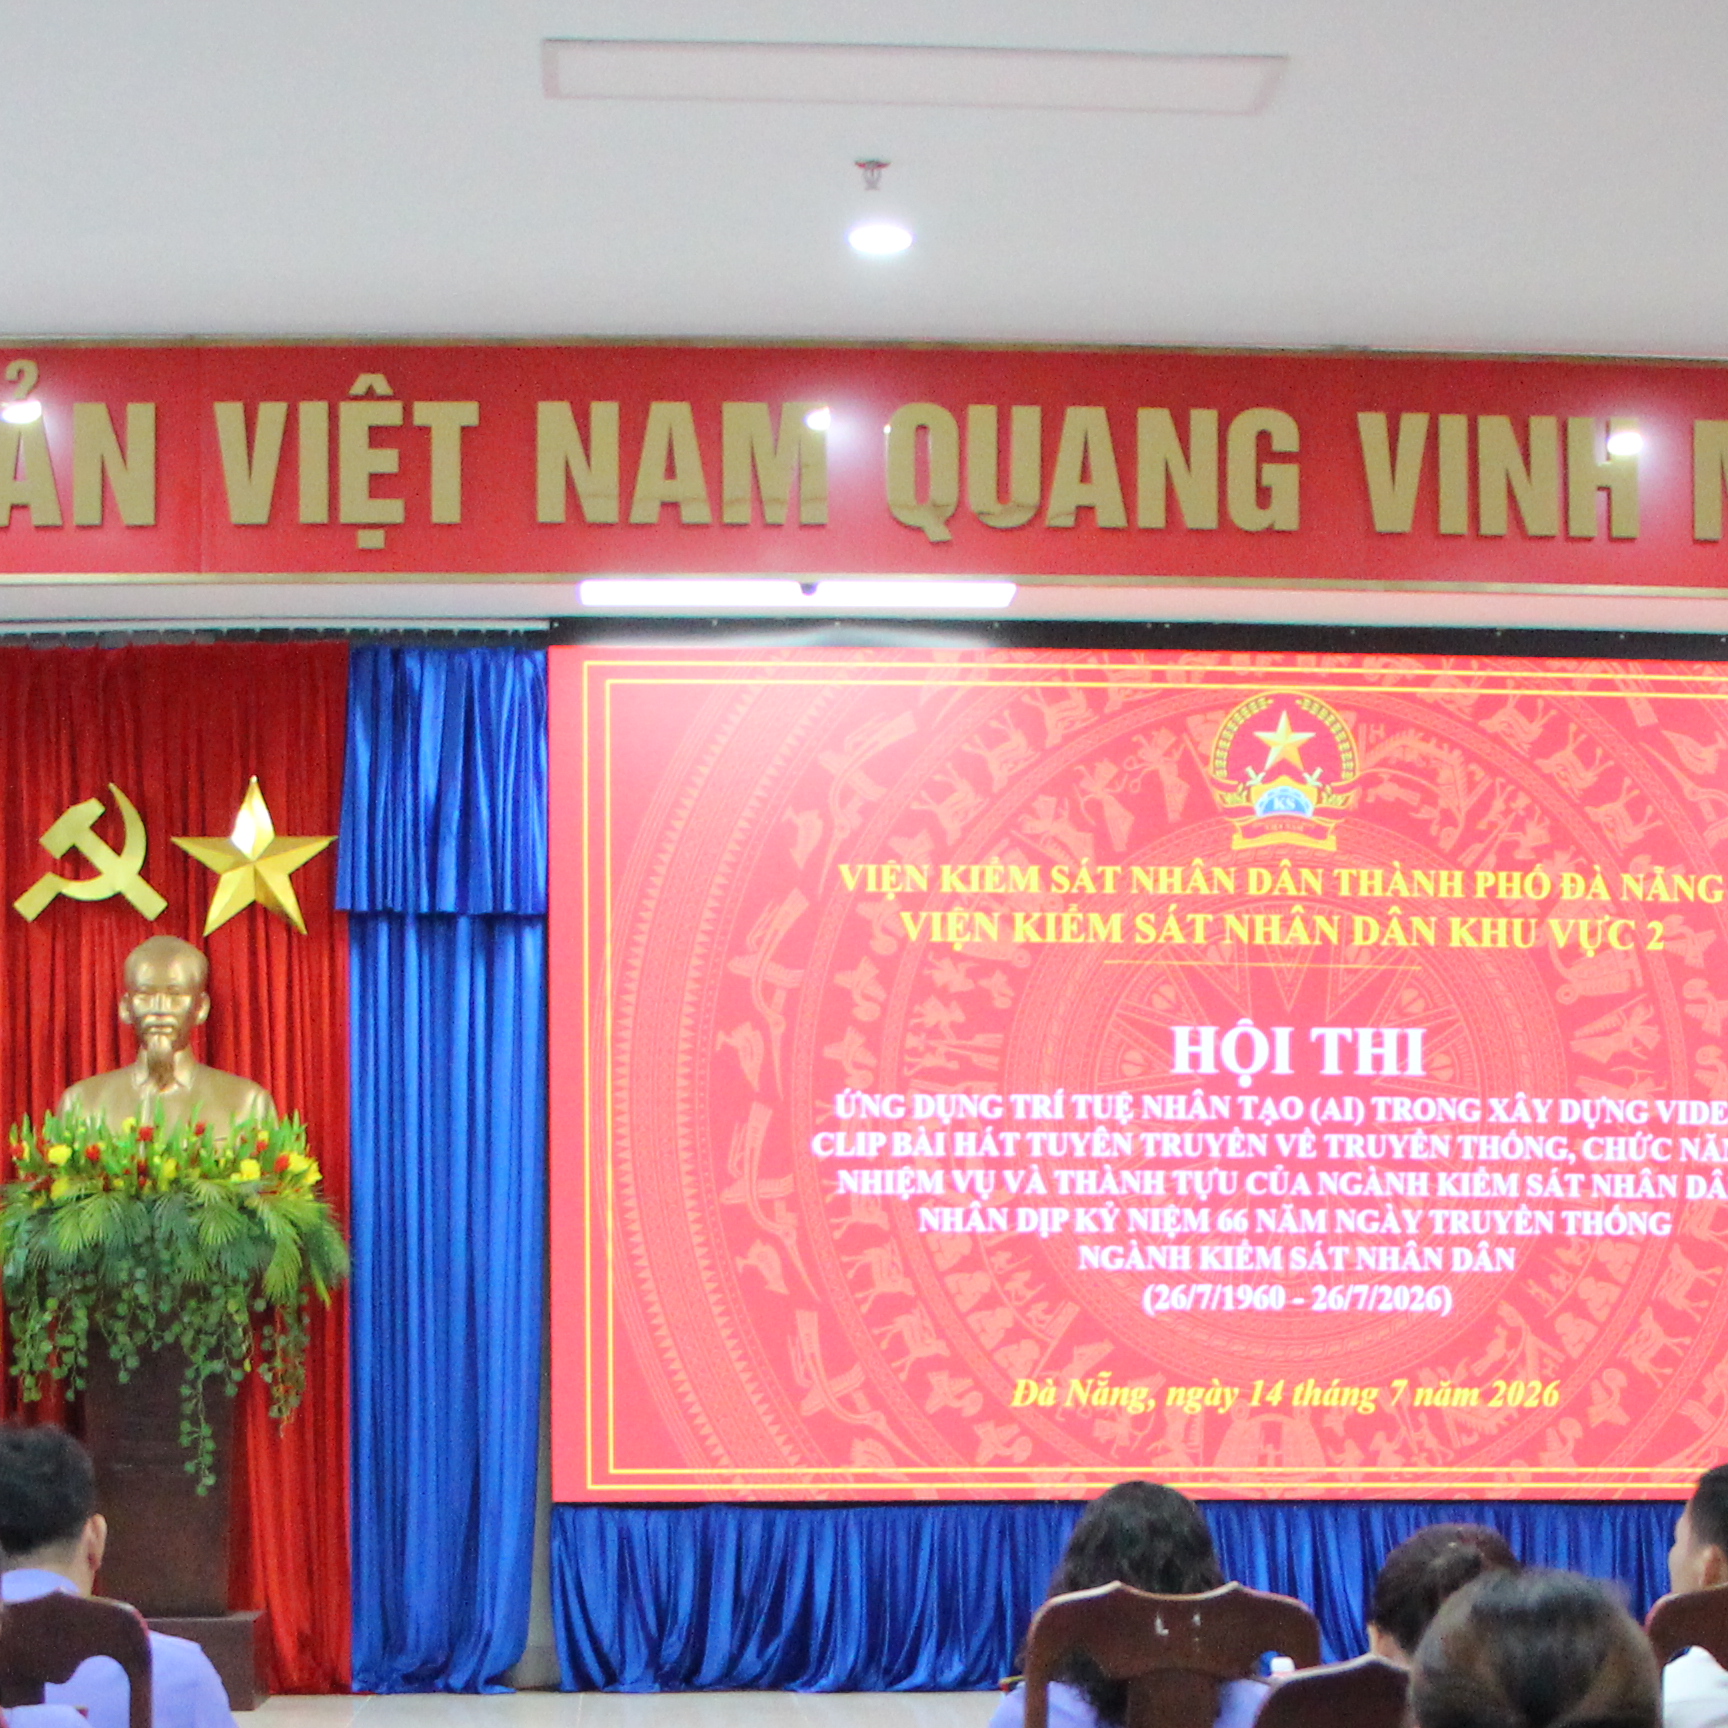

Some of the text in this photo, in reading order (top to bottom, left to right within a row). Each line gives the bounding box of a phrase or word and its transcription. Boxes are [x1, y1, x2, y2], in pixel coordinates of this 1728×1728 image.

[217, 372, 479, 550] VIỆT
[536, 401, 830, 526] NAM
[884, 402, 1300, 543] QUANG
[1358, 411, 1642, 541] VINH
[837, 856, 1724, 904] VIỆN KIỂM SÁT NHÂN DÂN THÀNH PHỐ ĐÀ NẴNG
[899, 903, 1665, 959] VIỆN KIỂM SÁT NHÂN DÂN KHU VỰC 2
[1171, 1016, 1424, 1089] HỘI THI
[835, 1087, 906, 1121] ỨNG
[911, 1092, 1004, 1131] DỤNG
[1009, 1087, 1065, 1121] TRÍ
[1070, 1089, 1135, 1131] TUỆ
[1141, 1088, 1230, 1122] NHÂN
[1237, 1095, 1305, 1132] TẠO
[1309, 1095, 1365, 1127] (AI)
[1370, 1095, 1482, 1124] TRONG
[1488, 1090, 1554, 1124] XÂY
[1559, 1094, 1650, 1130] DỰNG
[811, 1130, 888, 1160] CLIP
[891, 1124, 947, 1159] BÀI
[953, 1124, 1022, 1159] HÁT
[1025, 1125, 1134, 1159] TUYÊN
[1138, 1126, 1268, 1159] TRUYỀN
[1275, 1126, 1317, 1159] VỀ
[1323, 1127, 1452, 1161] TRUYỀN
[1456, 1127, 1577, 1165] THỐNG,
[1581, 1130, 1673, 1163] CHỨC
[836, 1165, 947, 1202] NHIỆM
[951, 1167, 996, 1203] VỤ
[1003, 1163, 1048, 1196] VÀ
[1053, 1163, 1167, 1197] THÀNH
[1171, 1166, 1239, 1202] TỰU
[1245, 1164, 1312, 1197] CỦA
[1317, 1164, 1430, 1199] NGÀNH
[1436, 1165, 1521, 1199] KIỂM
[1525, 1166, 1585, 1200] SÁT
[1590, 1166, 1678, 1200] NHÂN
[918, 1200, 1673, 1240] NHÂN DỊP KỶ NIỆM 66 NĂM NGÀY TRUYỀN THỐNG
[1079, 1238, 1516, 1273] NGÀNH KIỂM SÁT NHÂN DÂN
[1142, 1282, 1287, 1318] (26/7/1960
[1311, 1283, 1453, 1317] 26/7/2026)
[1010, 1370, 1560, 1416] Đà Nẵng, ngày 14 tháng 7 năm 2026
